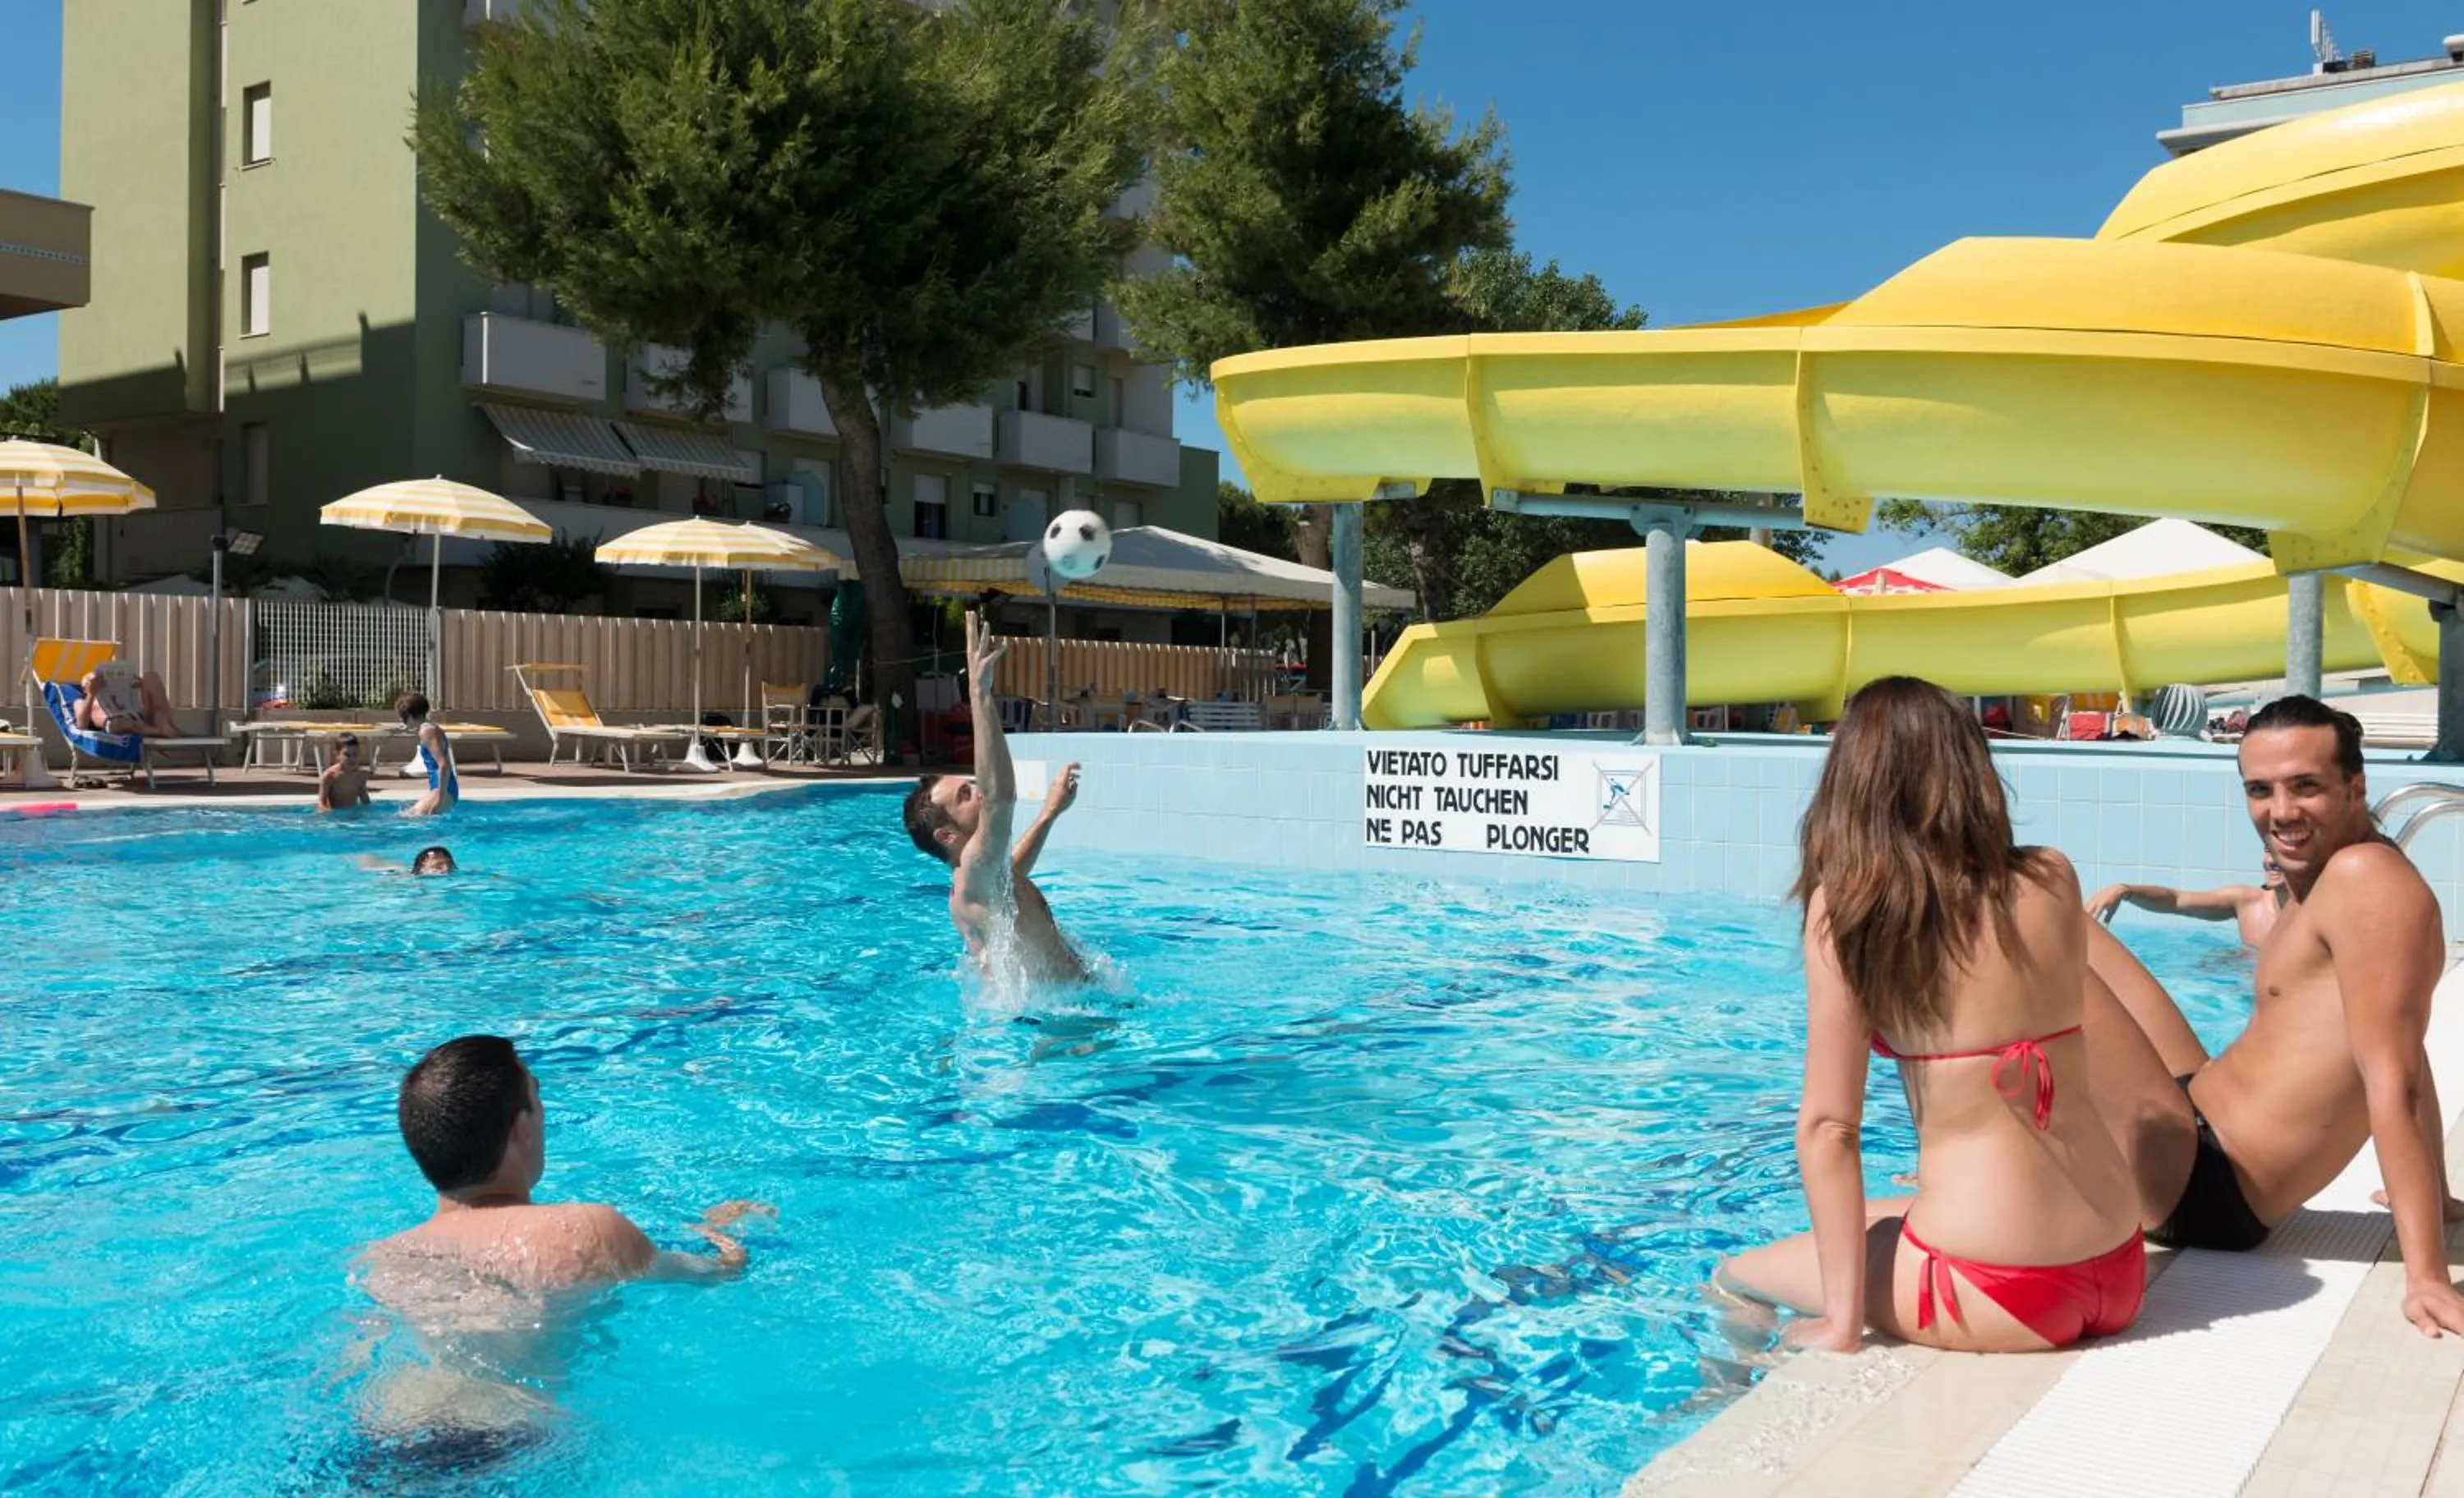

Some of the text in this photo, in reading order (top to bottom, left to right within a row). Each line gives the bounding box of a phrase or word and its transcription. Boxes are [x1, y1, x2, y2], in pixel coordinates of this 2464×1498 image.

[1367, 750, 1559, 781] VIETATO TUFFARSI
[1366, 784, 1529, 816] NICHT TAUCHEN
[1366, 818, 1589, 854] NE PAS PLONGER
